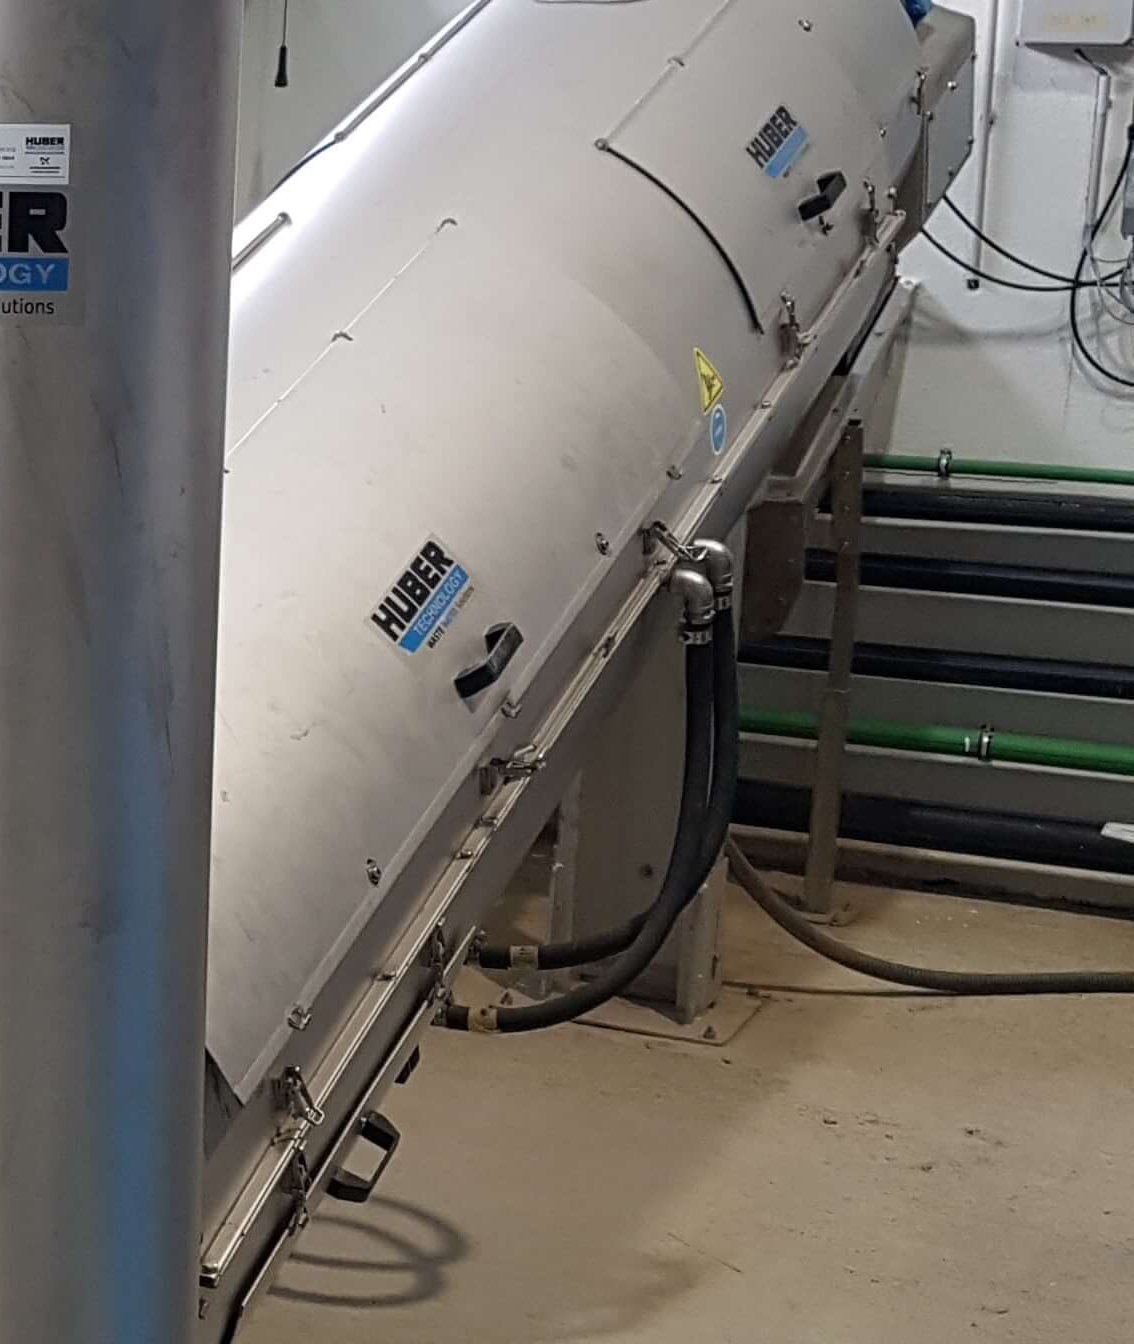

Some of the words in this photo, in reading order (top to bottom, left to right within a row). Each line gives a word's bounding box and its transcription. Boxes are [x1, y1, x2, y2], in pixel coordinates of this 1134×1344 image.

[26, 137, 64, 145] HUBER
[746, 106, 798, 169] HUBER
[371, 541, 454, 642] HUBER
[413, 567, 465, 636] TECHNOLOGY
